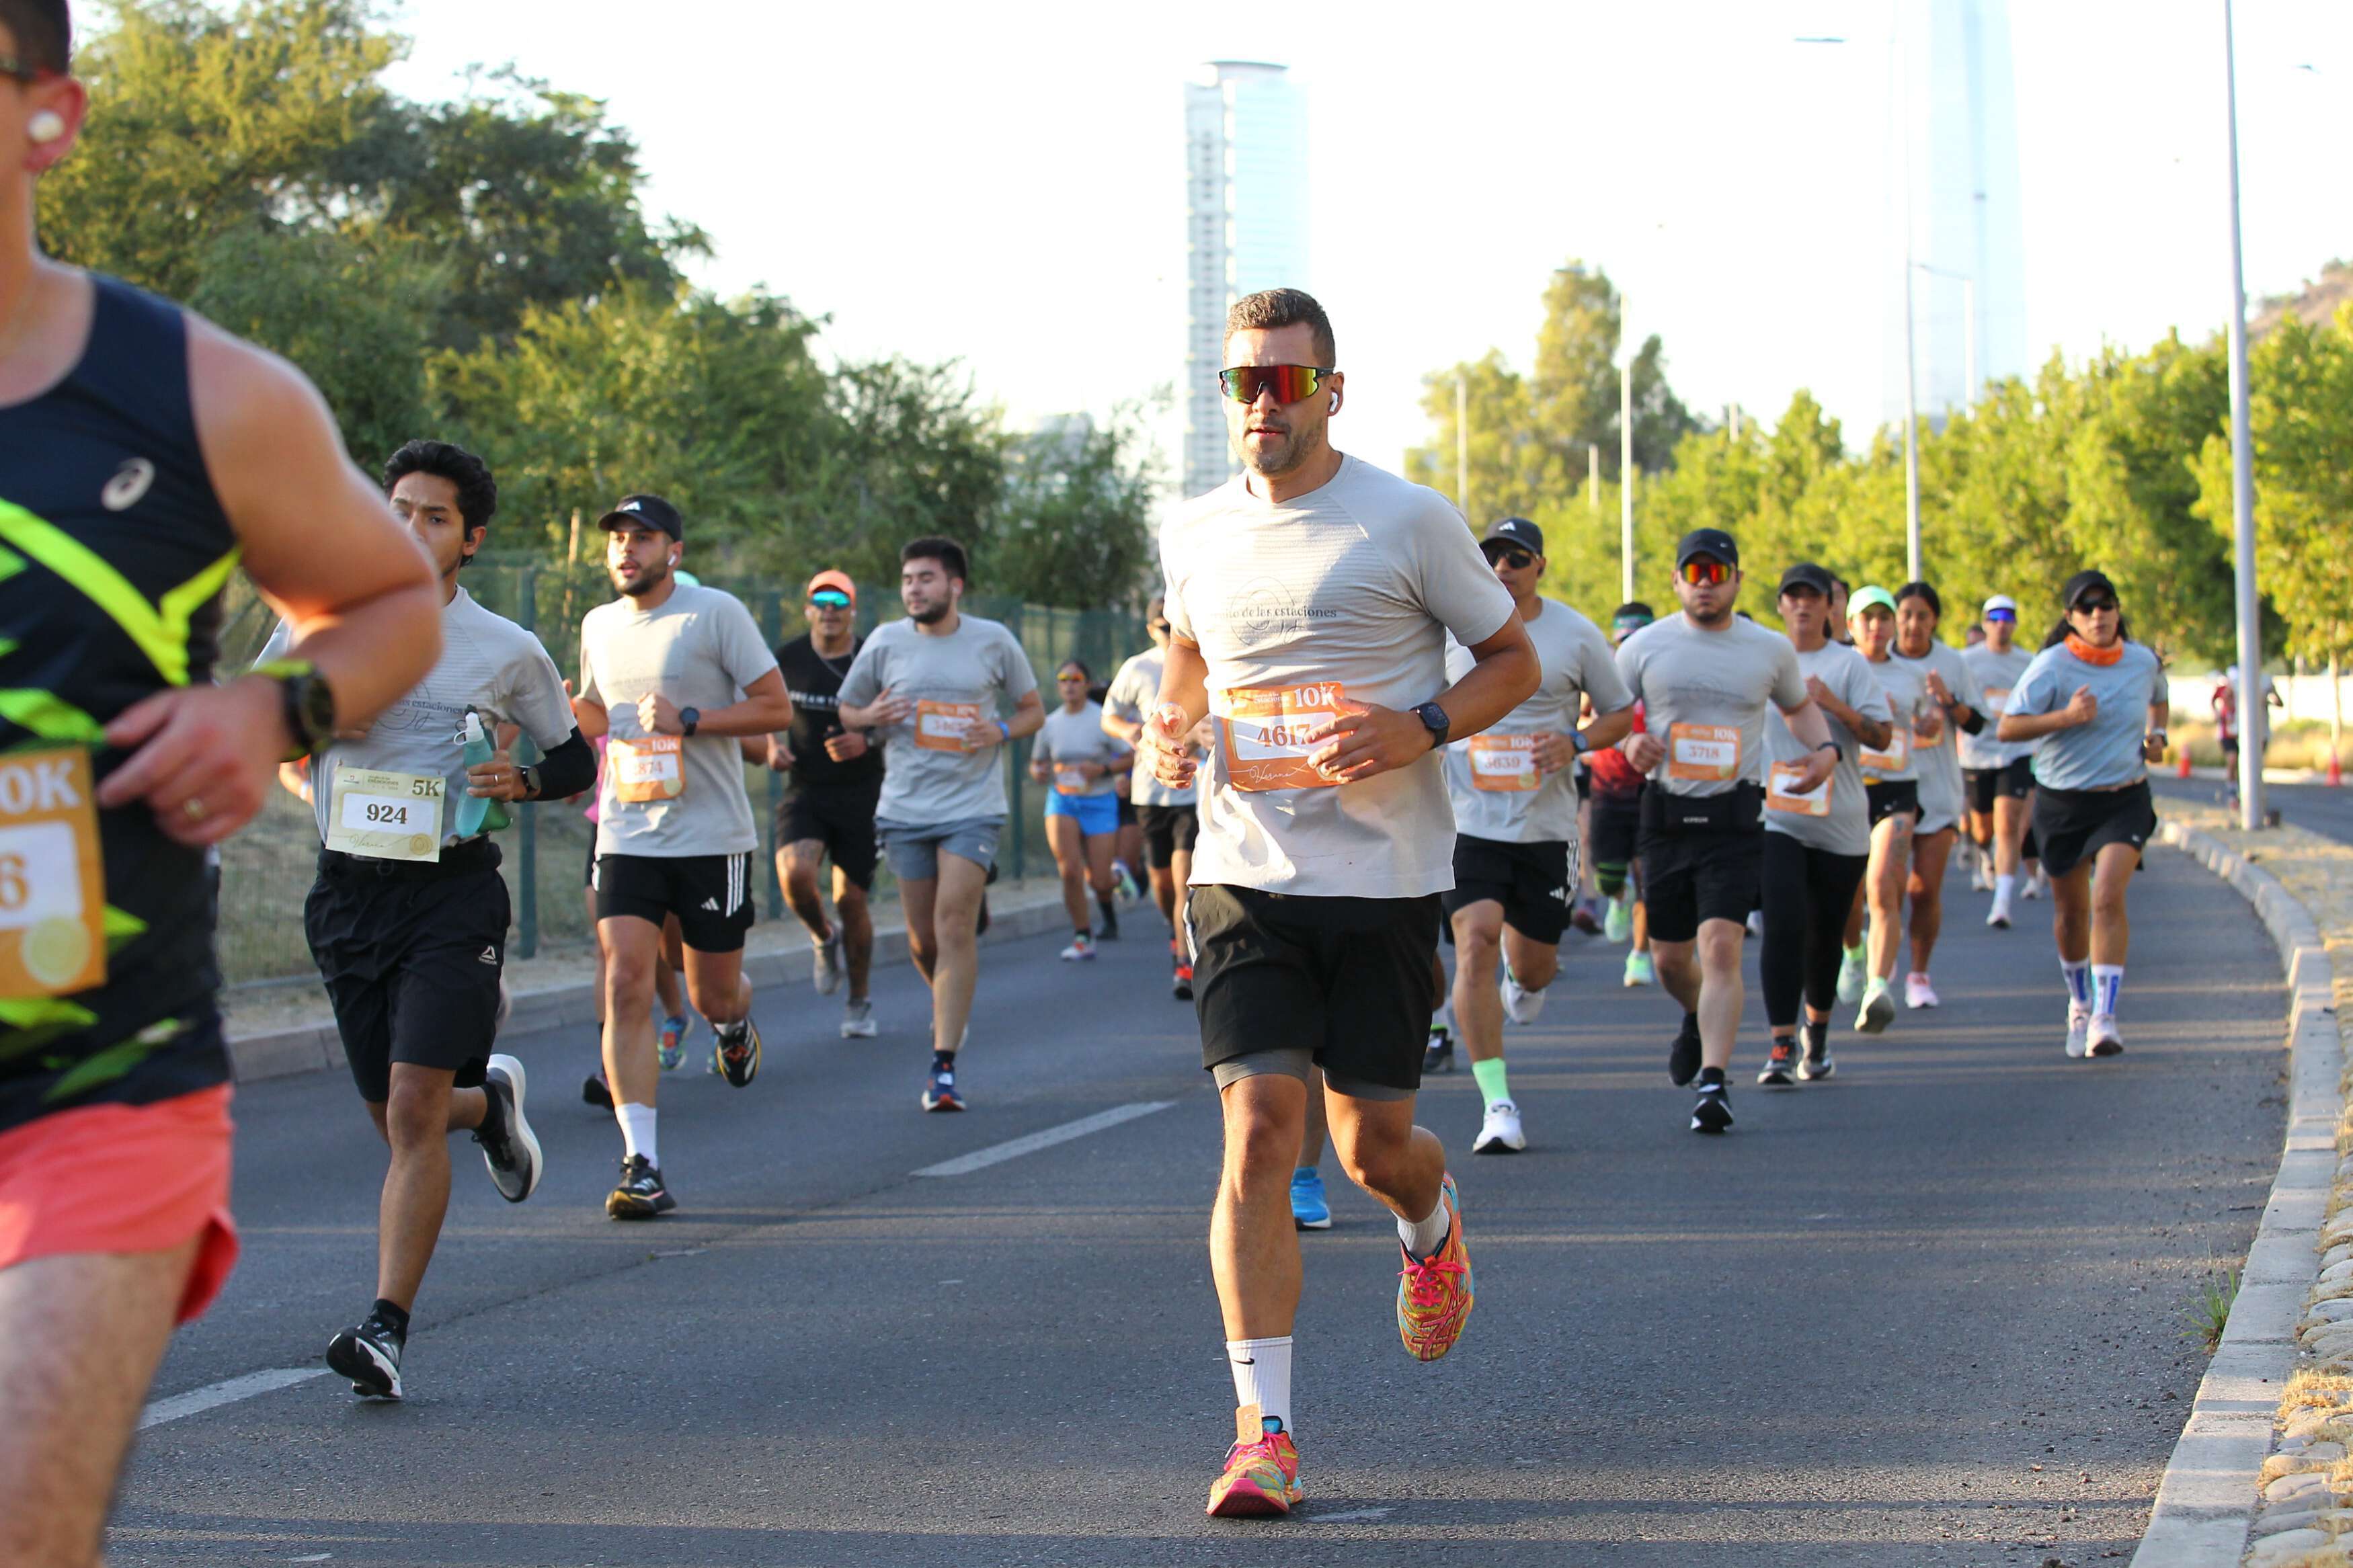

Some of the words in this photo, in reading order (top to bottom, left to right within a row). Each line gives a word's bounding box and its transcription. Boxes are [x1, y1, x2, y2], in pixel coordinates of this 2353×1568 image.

[1275, 606, 1337, 618] estaciones
[1293, 686, 1335, 708] 10K
[412, 700, 463, 714] estaciones
[1258, 724, 1310, 747] 4617
[1714, 728, 1737, 741] 10K
[653, 737, 678, 753] 10K
[0, 759, 80, 815] 0K
[411, 780, 441, 797] 5K
[366, 803, 407, 825] 924
